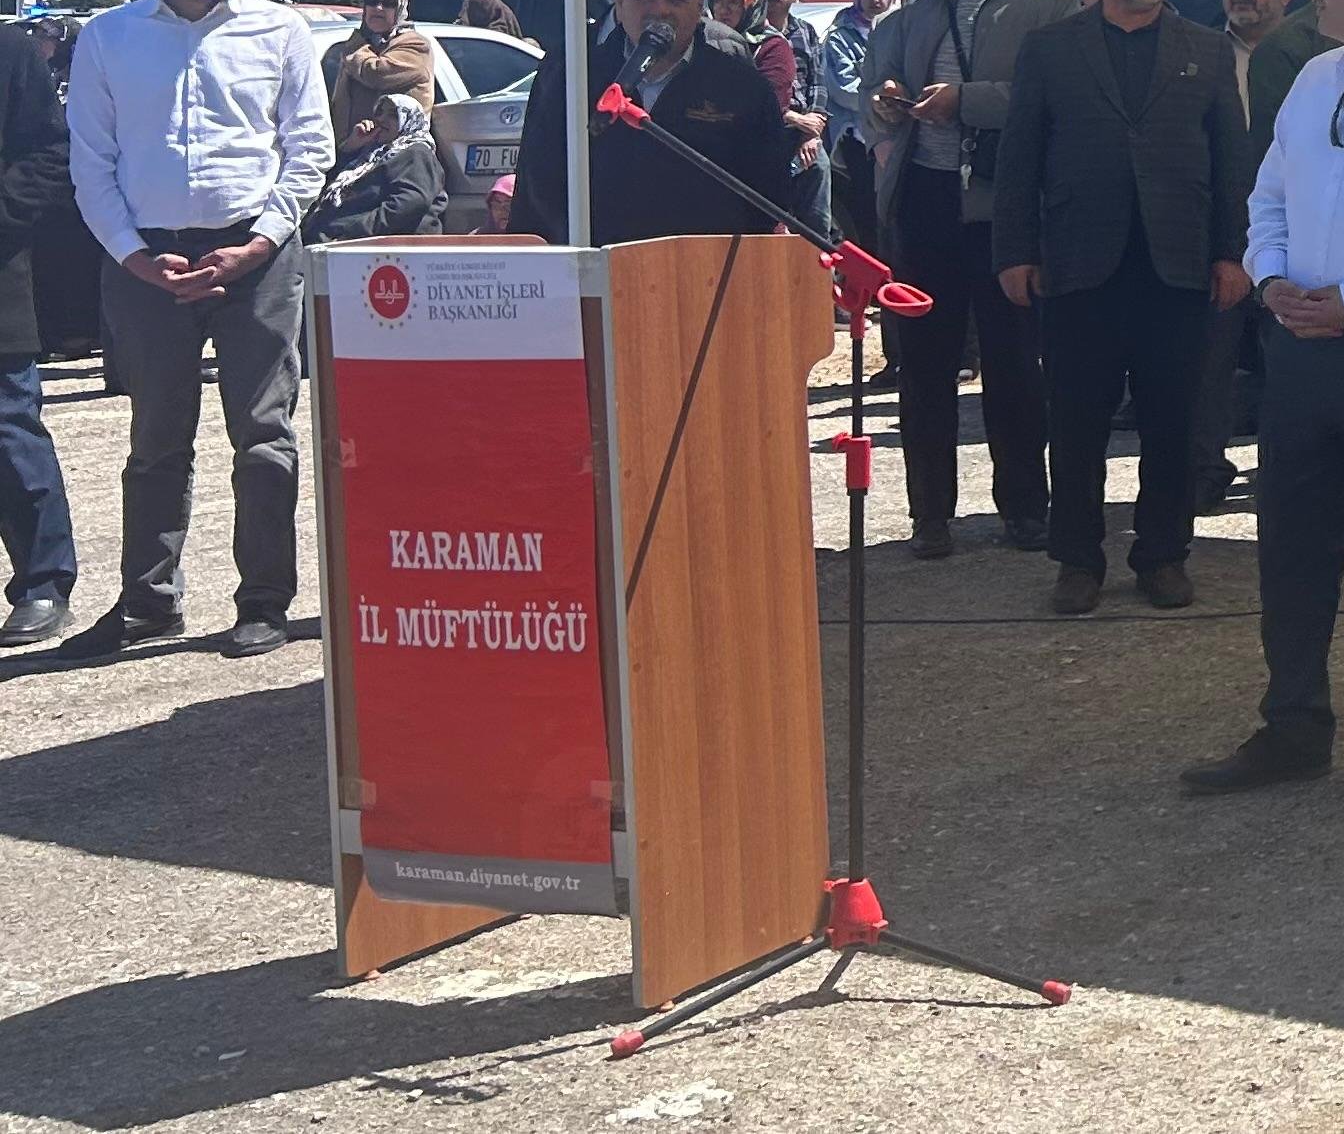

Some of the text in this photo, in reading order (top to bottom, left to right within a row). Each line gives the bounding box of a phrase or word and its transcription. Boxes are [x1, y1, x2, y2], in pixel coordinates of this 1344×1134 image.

[475, 148, 491, 167] 70
[427, 279, 545, 304] DİYANET İŞLERİ
[428, 301, 519, 324] BAŞKANLIĞI
[389, 529, 543, 572] KARAMAN
[358, 594, 588, 653] İL MÜFTÜLÜĞÜ
[394, 861, 582, 893] karaman.diyanet.gov.tr
